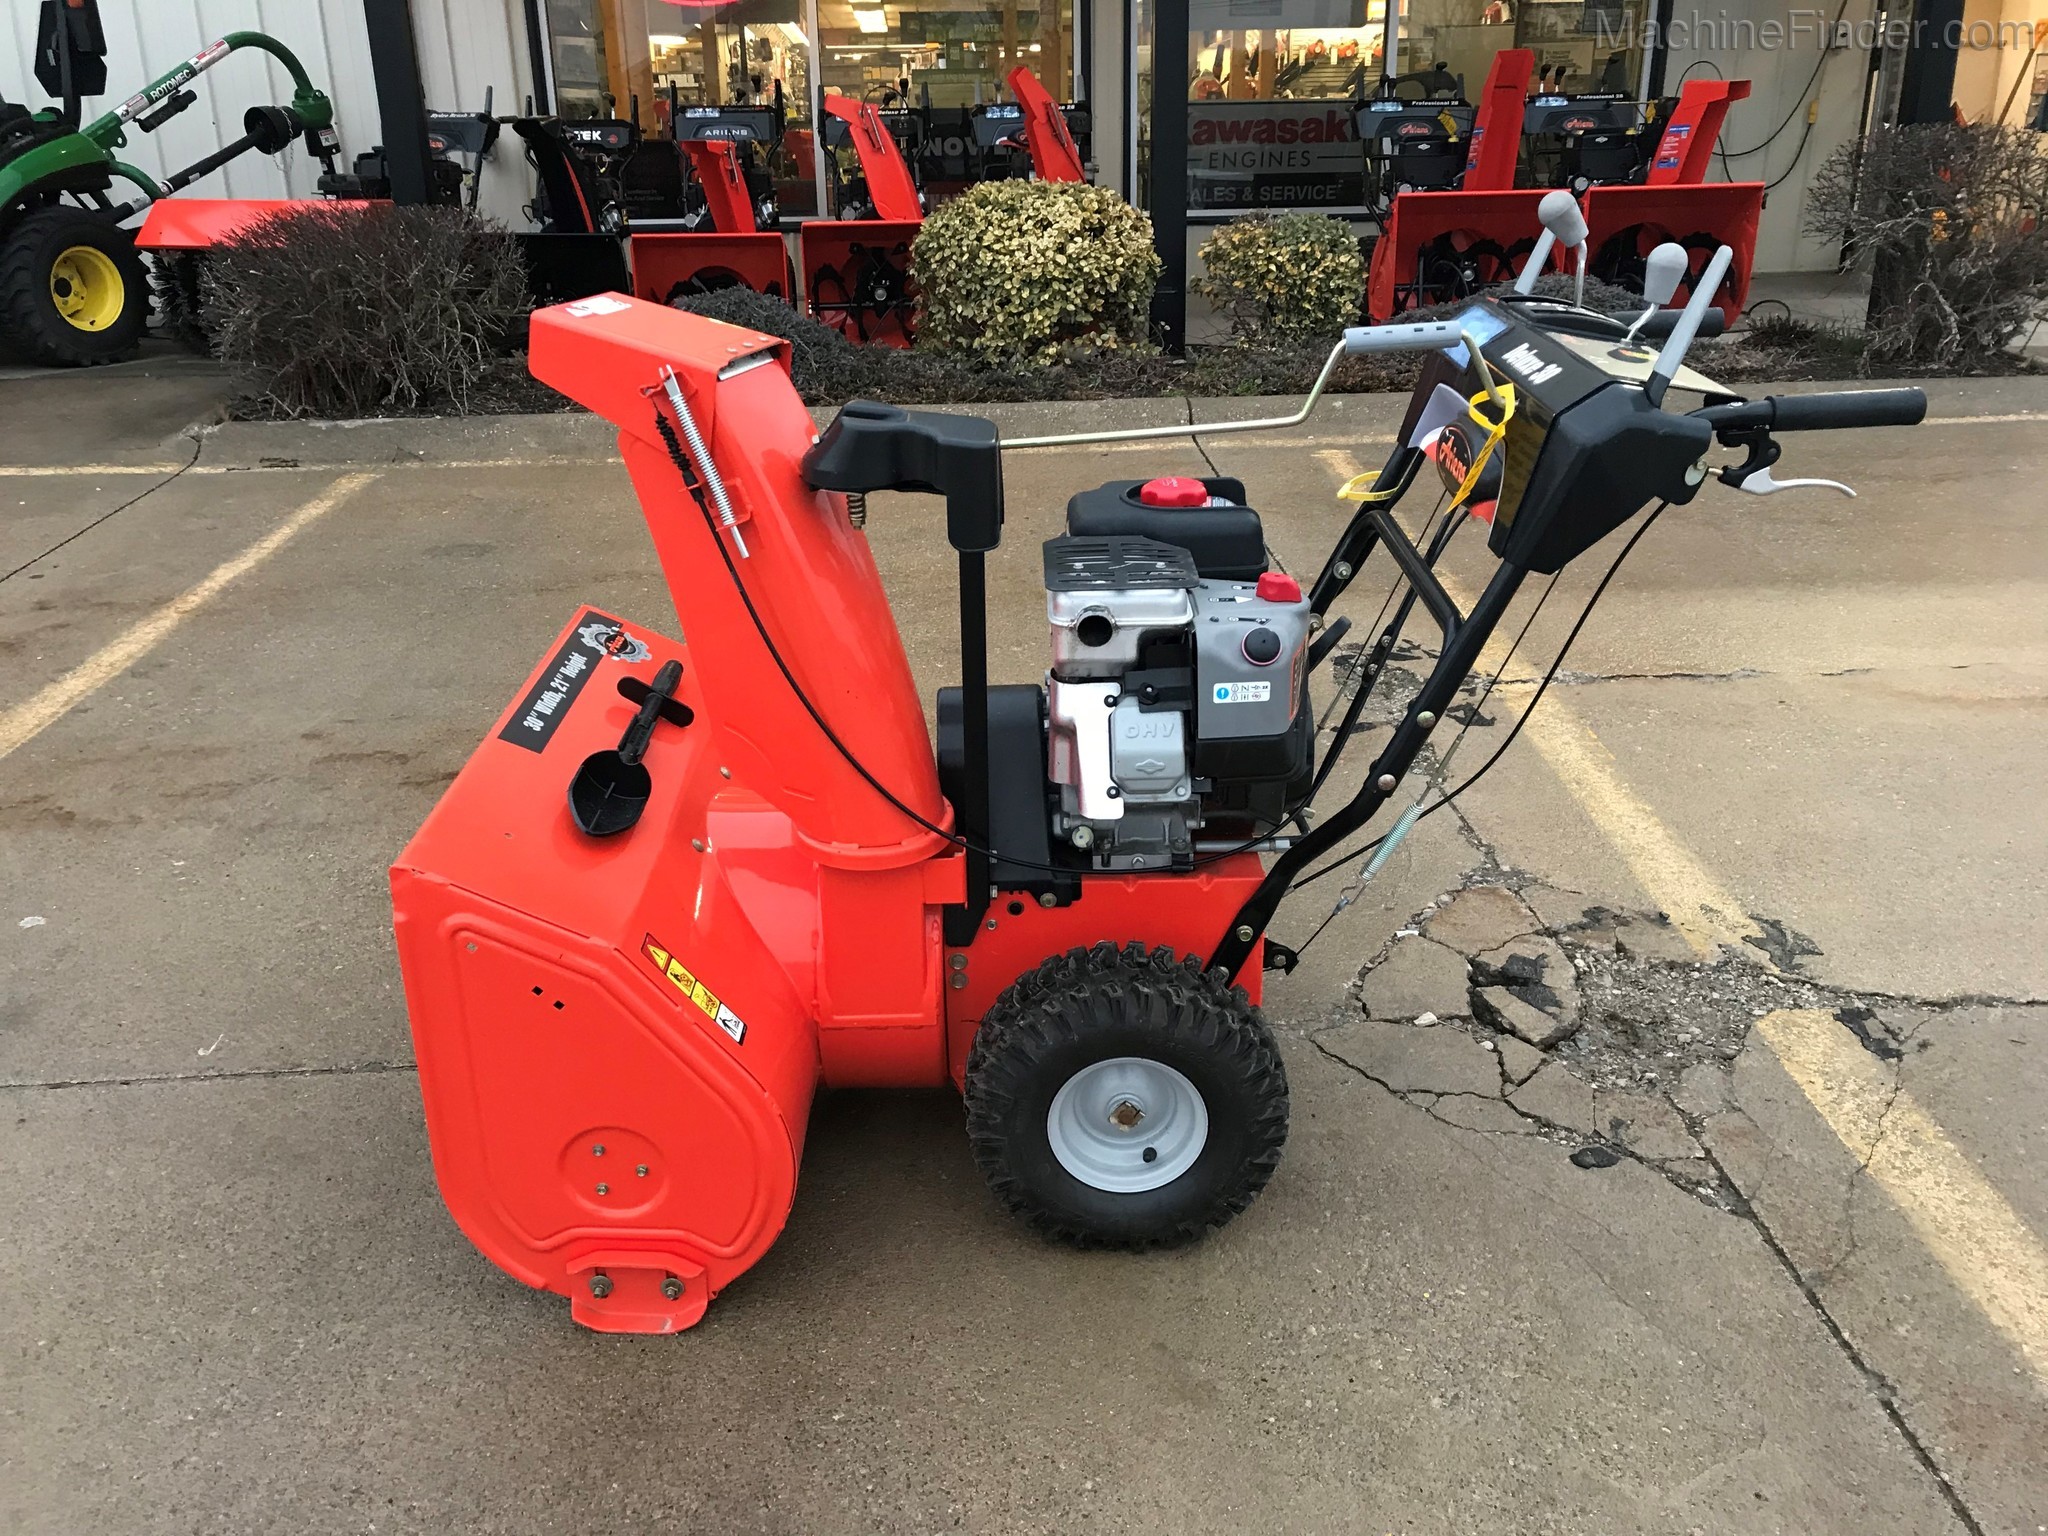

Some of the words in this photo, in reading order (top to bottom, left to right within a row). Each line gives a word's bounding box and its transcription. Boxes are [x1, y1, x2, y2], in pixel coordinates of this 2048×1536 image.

[150, 69, 191, 100] ROTOMEC
[1188, 110, 1352, 146] awasak
[1208, 150, 1312, 169] ENGINES
[1188, 186, 1238, 203] ALES
[1241, 186, 1254, 201] &
[1259, 184, 1338, 201] SERVICE
[1501, 342, 1545, 376] Deluxe
[1528, 363, 1563, 385] 30
[1438, 434, 1468, 485] Ariens
[560, 652, 588, 679] Height
[1125, 722, 1175, 739] OHV
